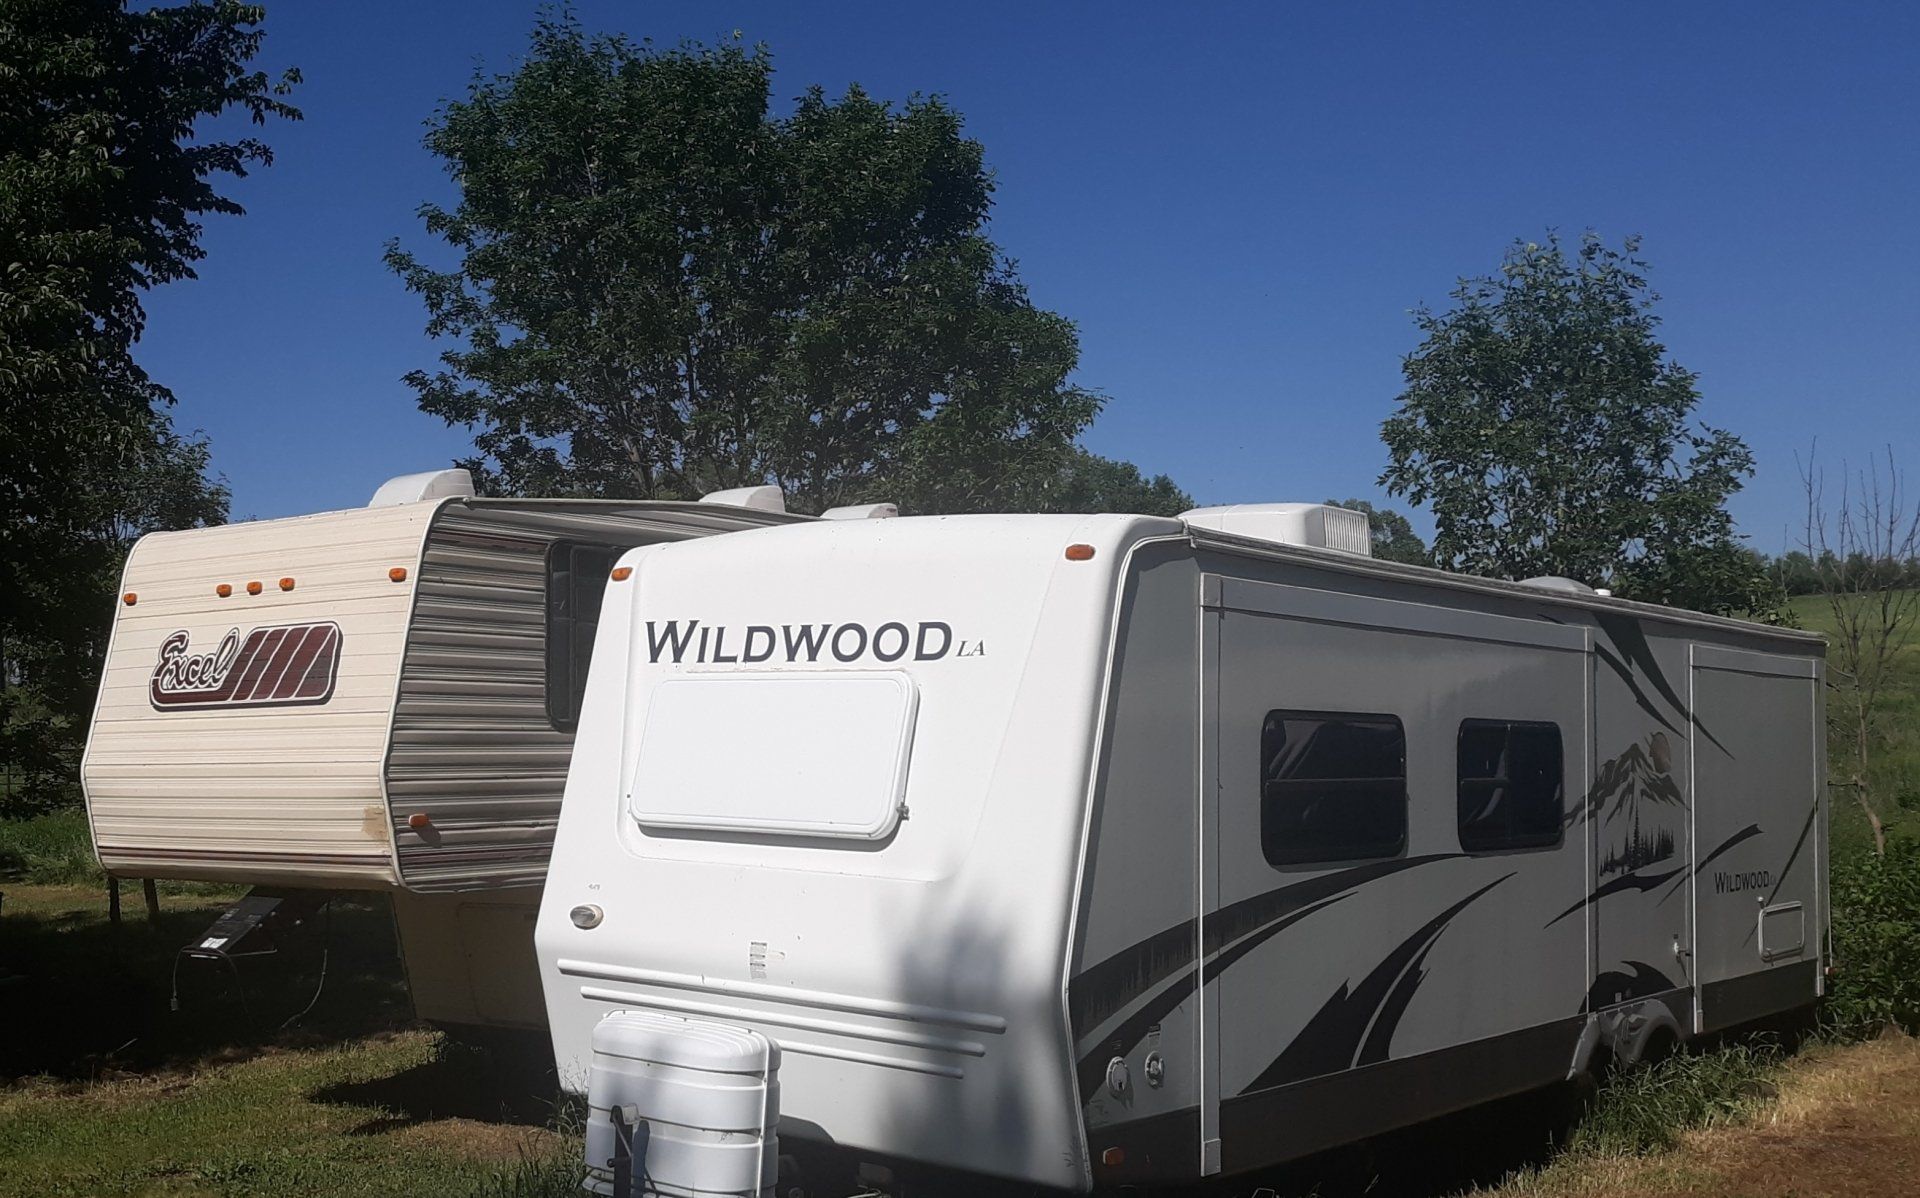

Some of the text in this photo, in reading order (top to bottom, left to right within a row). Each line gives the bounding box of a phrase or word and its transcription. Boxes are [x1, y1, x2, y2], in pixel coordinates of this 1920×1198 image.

[153, 628, 240, 690] Excel
[645, 620, 986, 663] WILDWOOD LA
[1714, 871, 1770, 894] WILDWOOD
